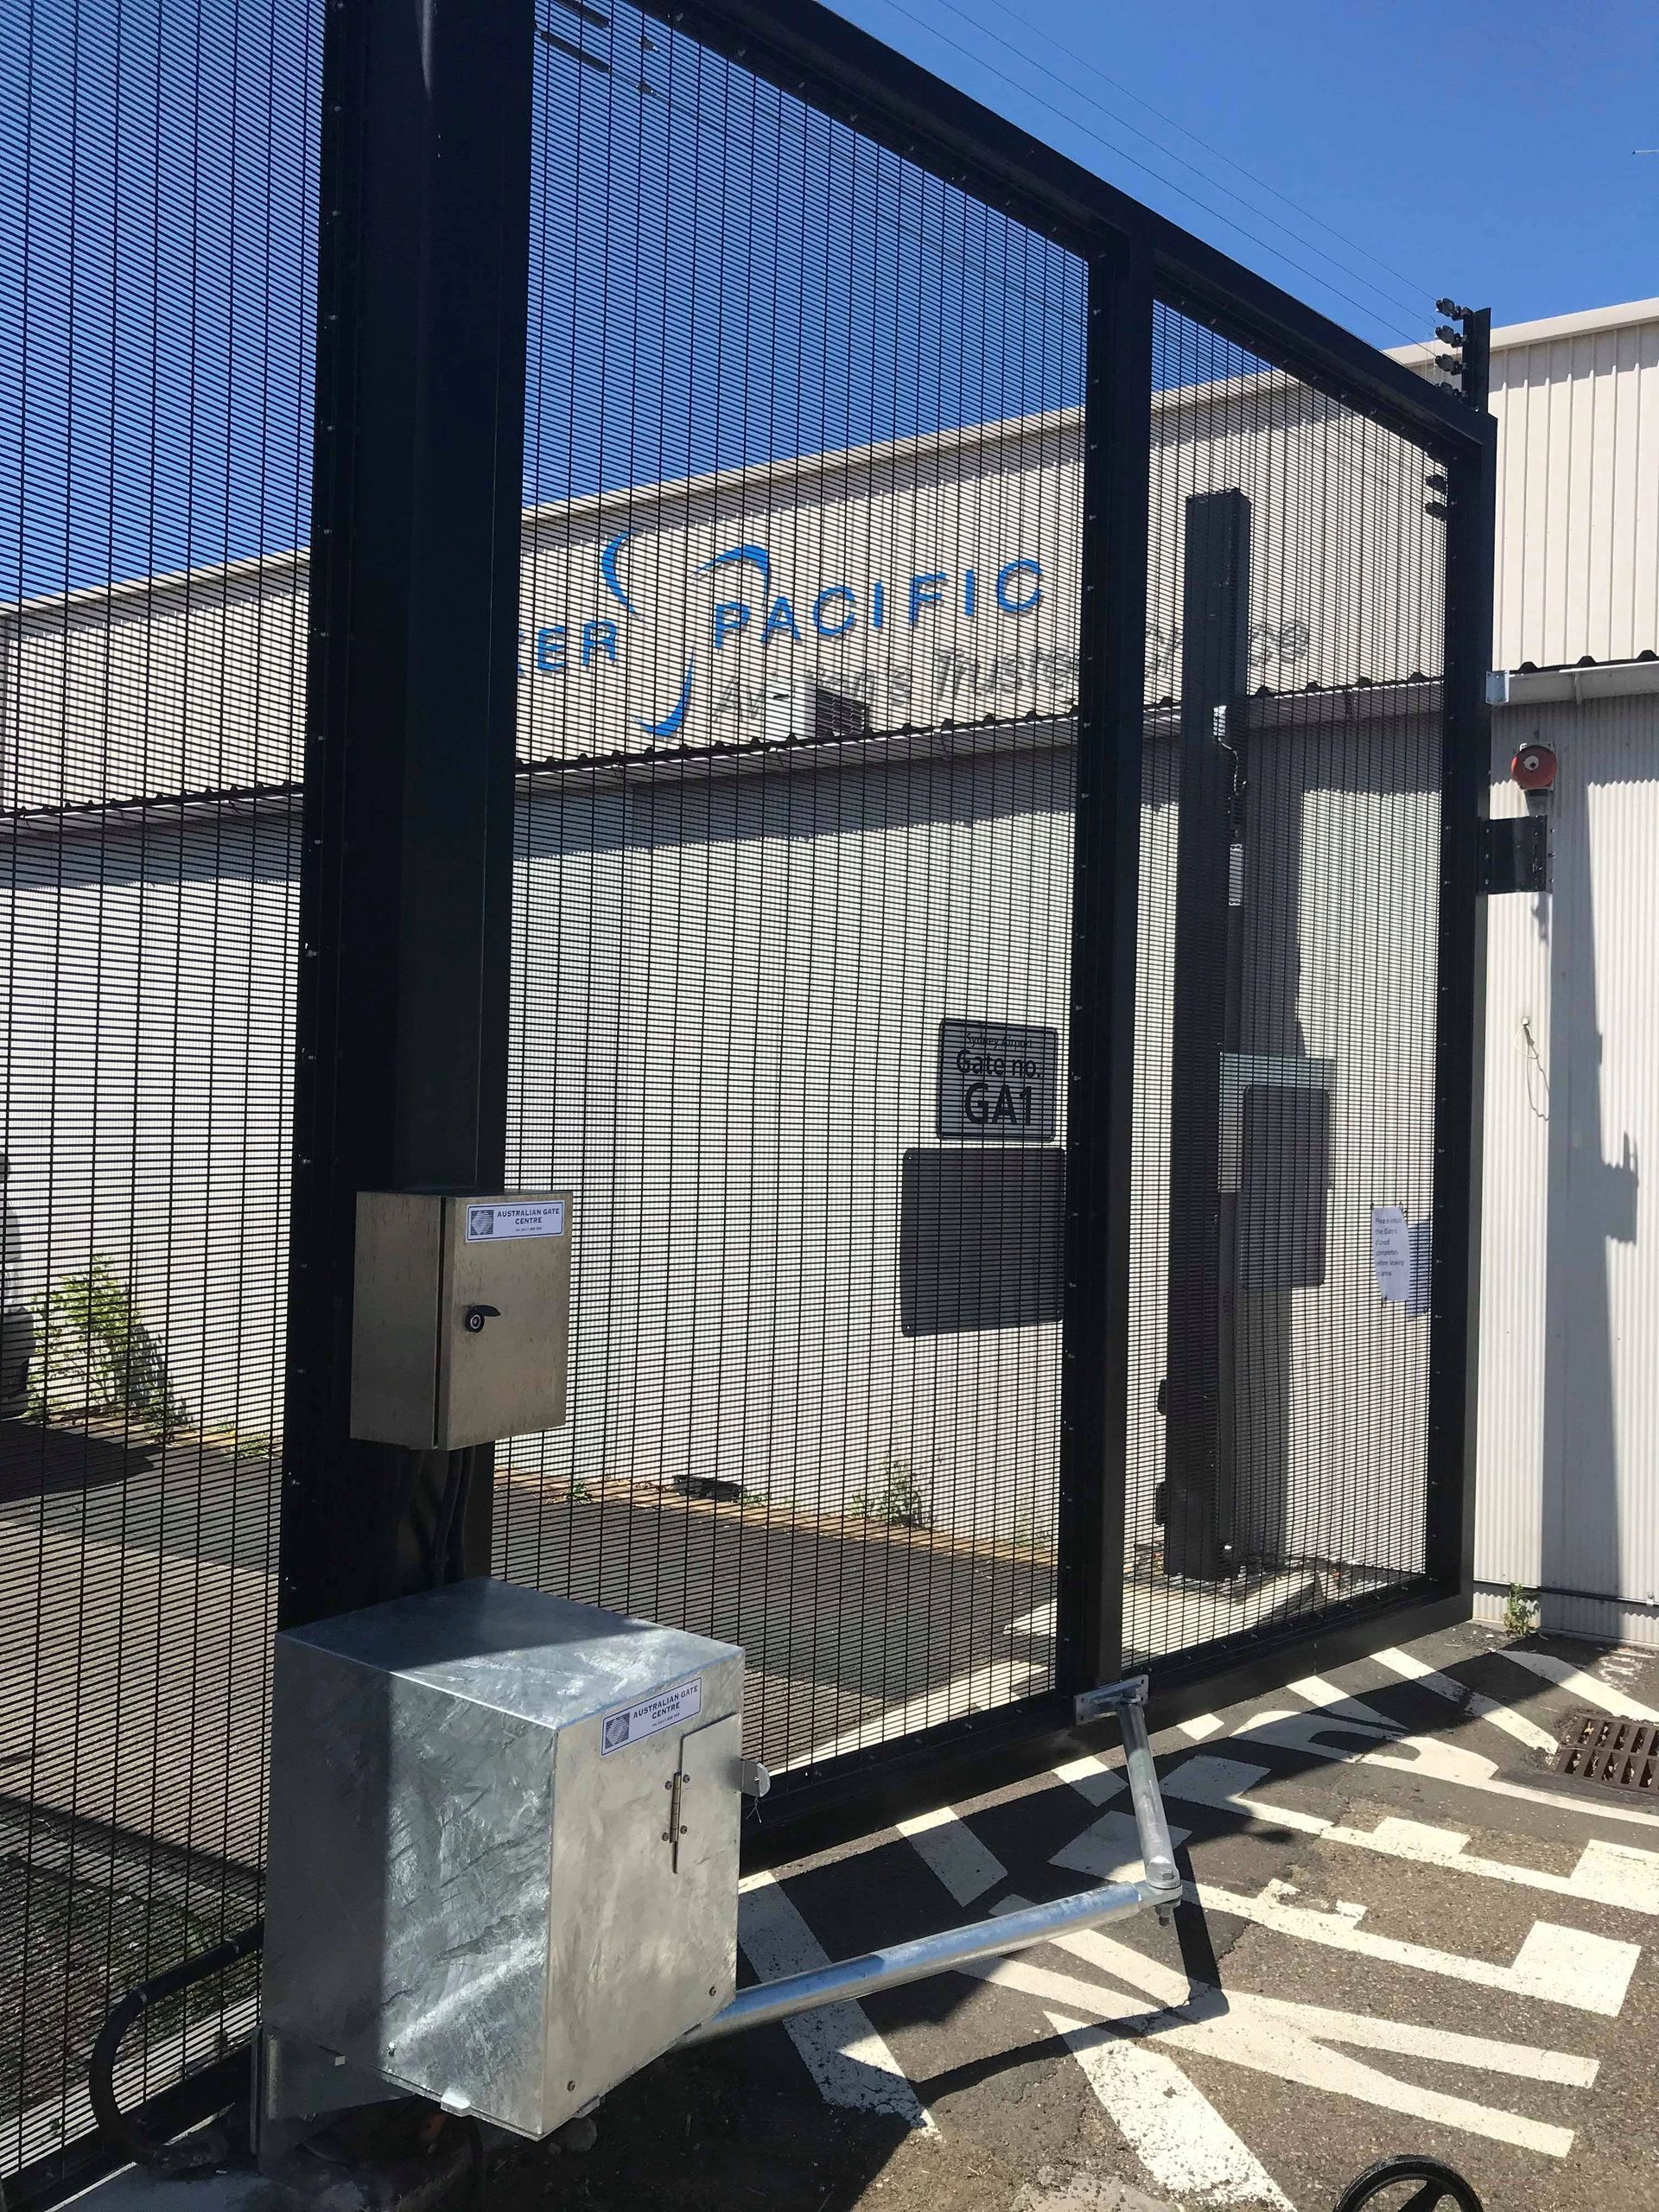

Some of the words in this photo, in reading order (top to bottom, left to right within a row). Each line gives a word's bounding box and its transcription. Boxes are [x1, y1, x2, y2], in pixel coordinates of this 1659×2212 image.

[715, 557, 1045, 650] PACIFIC
[932, 644, 1080, 702] Truste
[957, 1049, 1006, 1076] Gate
[1012, 1058, 1041, 1078] no.
[964, 1083, 1033, 1126] GA1
[632, 1693, 679, 1719] AUSTRALIAN
[680, 1685, 698, 1698] GATE
[652, 1701, 680, 1719] CENTRE
